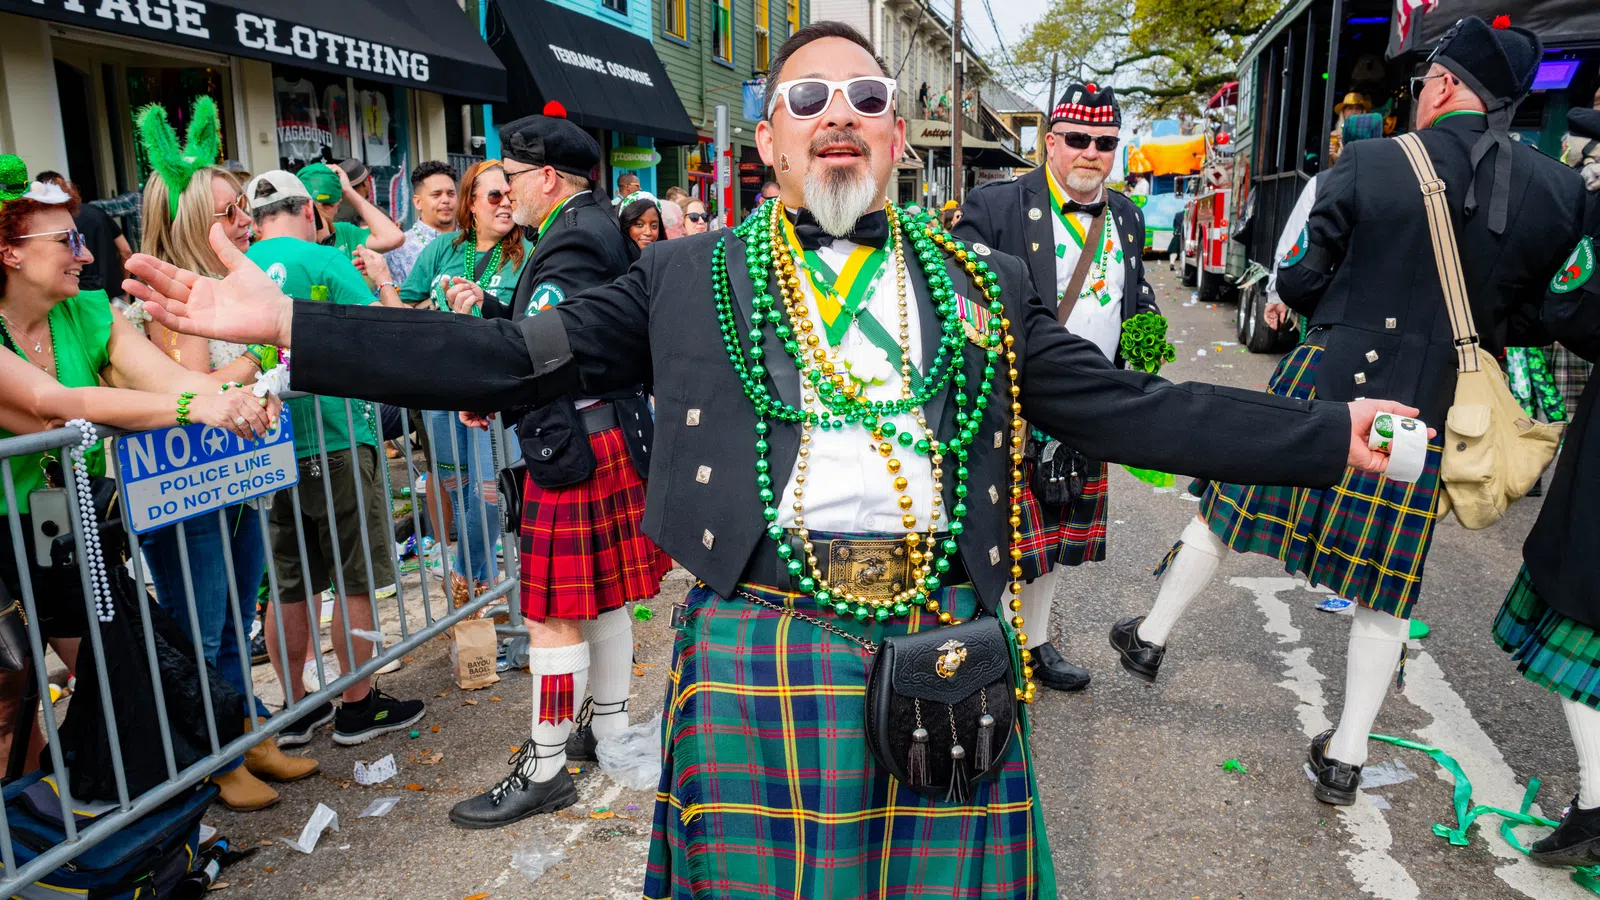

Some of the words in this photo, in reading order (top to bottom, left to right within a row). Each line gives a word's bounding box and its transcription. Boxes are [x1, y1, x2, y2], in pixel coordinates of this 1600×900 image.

[235, 13, 430, 82] CLOTHING
[549, 44, 607, 75] TERRANCE
[606, 61, 654, 87] OSBORNE
[277, 125, 333, 148] VAGABOND
[978, 171, 1005, 180] Magazine
[160, 464, 230, 495] POLICE
[235, 453, 272, 474] LINE
[148, 501, 178, 520] DO
[184, 487, 222, 510] NOT
[227, 468, 286, 496] CROSS
[467, 660, 490, 668] BAYOU
[469, 667, 490, 675] BAGEL
